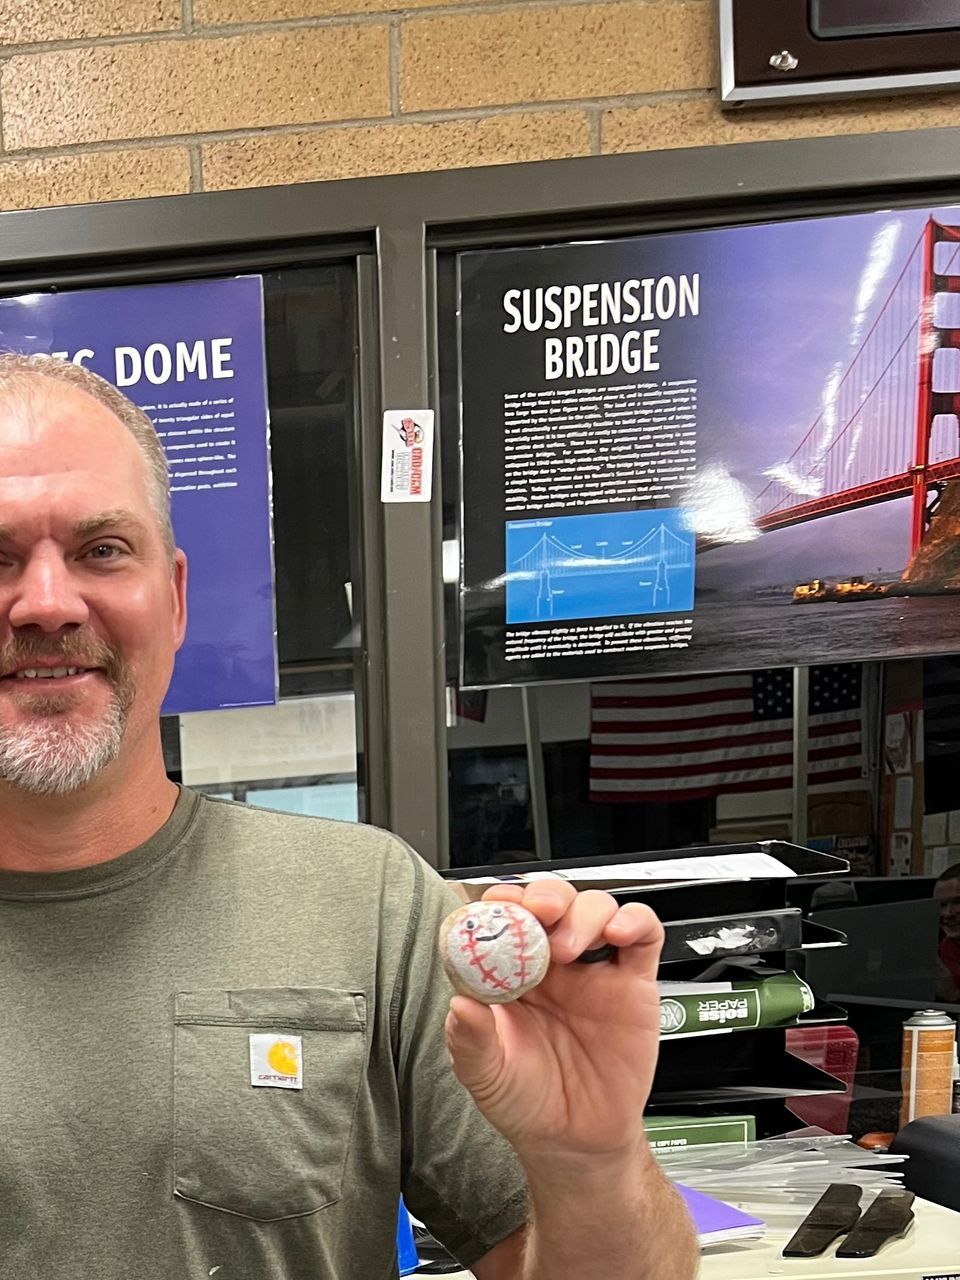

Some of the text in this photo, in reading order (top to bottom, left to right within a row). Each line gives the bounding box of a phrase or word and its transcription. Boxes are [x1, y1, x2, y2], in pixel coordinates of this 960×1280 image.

[503, 273, 699, 333] SUSPENSION
[115, 338, 234, 387] DOME
[545, 329, 660, 380] BRIDGE
[698, 999, 748, 1011] PAPER
